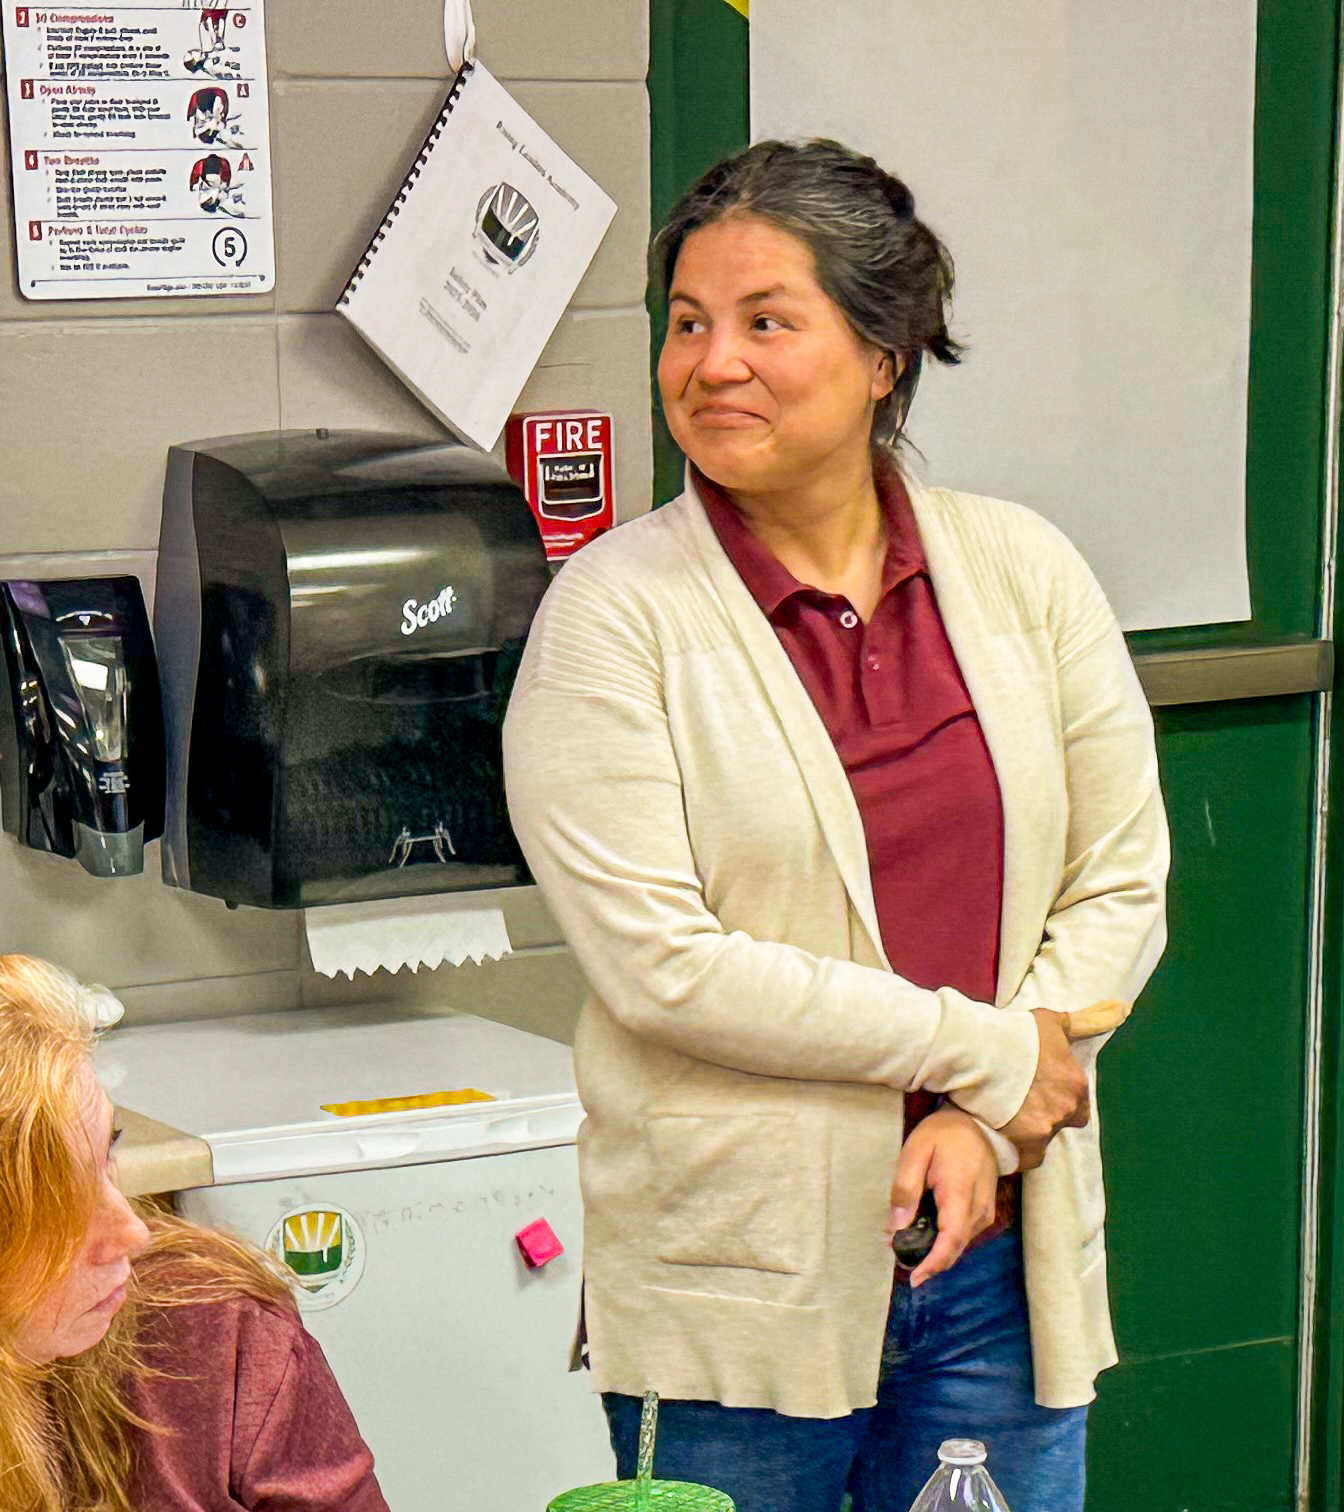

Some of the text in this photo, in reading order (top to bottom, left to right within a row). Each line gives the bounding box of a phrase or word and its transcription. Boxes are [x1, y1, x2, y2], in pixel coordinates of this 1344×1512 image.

[223, 236, 236, 258] 5
[536, 419, 603, 452] FIRE
[401, 585, 453, 635] Scott
